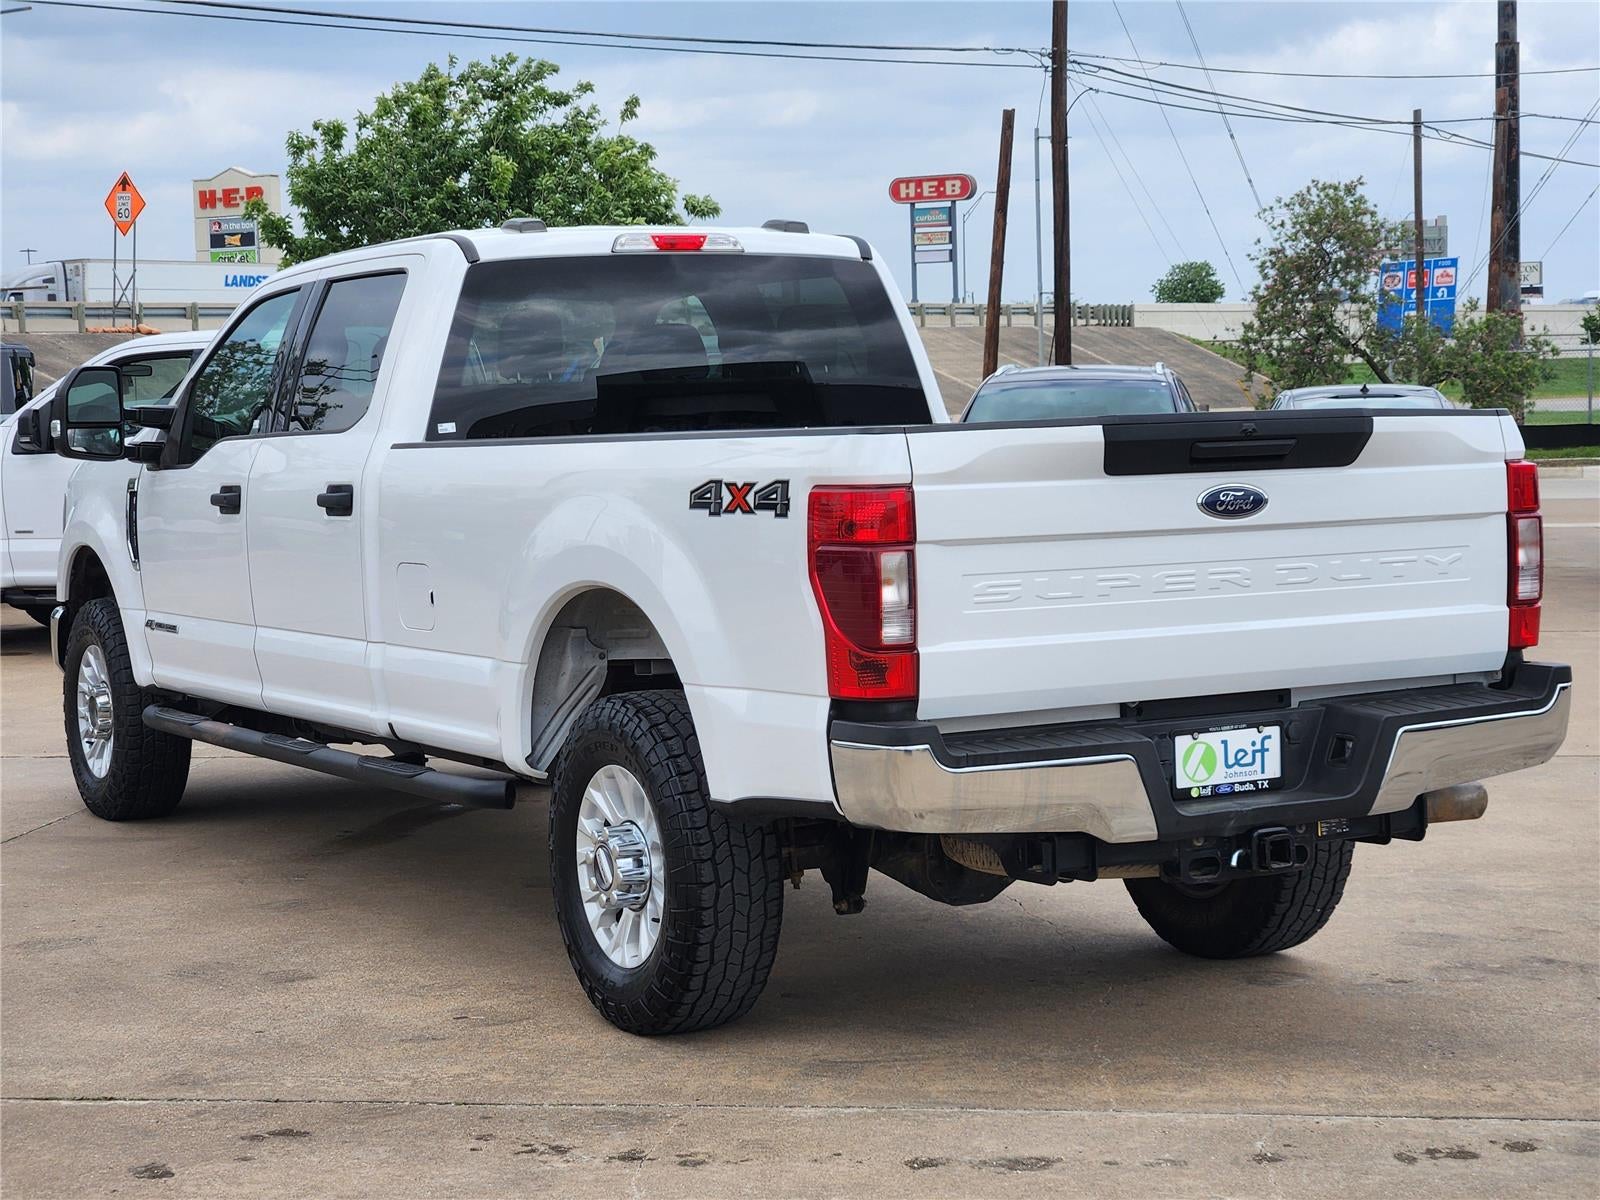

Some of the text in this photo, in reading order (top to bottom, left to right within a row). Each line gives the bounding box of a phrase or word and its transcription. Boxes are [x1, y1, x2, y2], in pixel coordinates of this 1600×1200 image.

[117, 207, 130, 218] 60
[1216, 491, 1254, 511] Ford
[973, 553, 1464, 604] SUPER DUTY
[1224, 769, 1258, 779] Johnson
[1234, 782, 1256, 792] Buda,
[1257, 780, 1269, 789] TX
